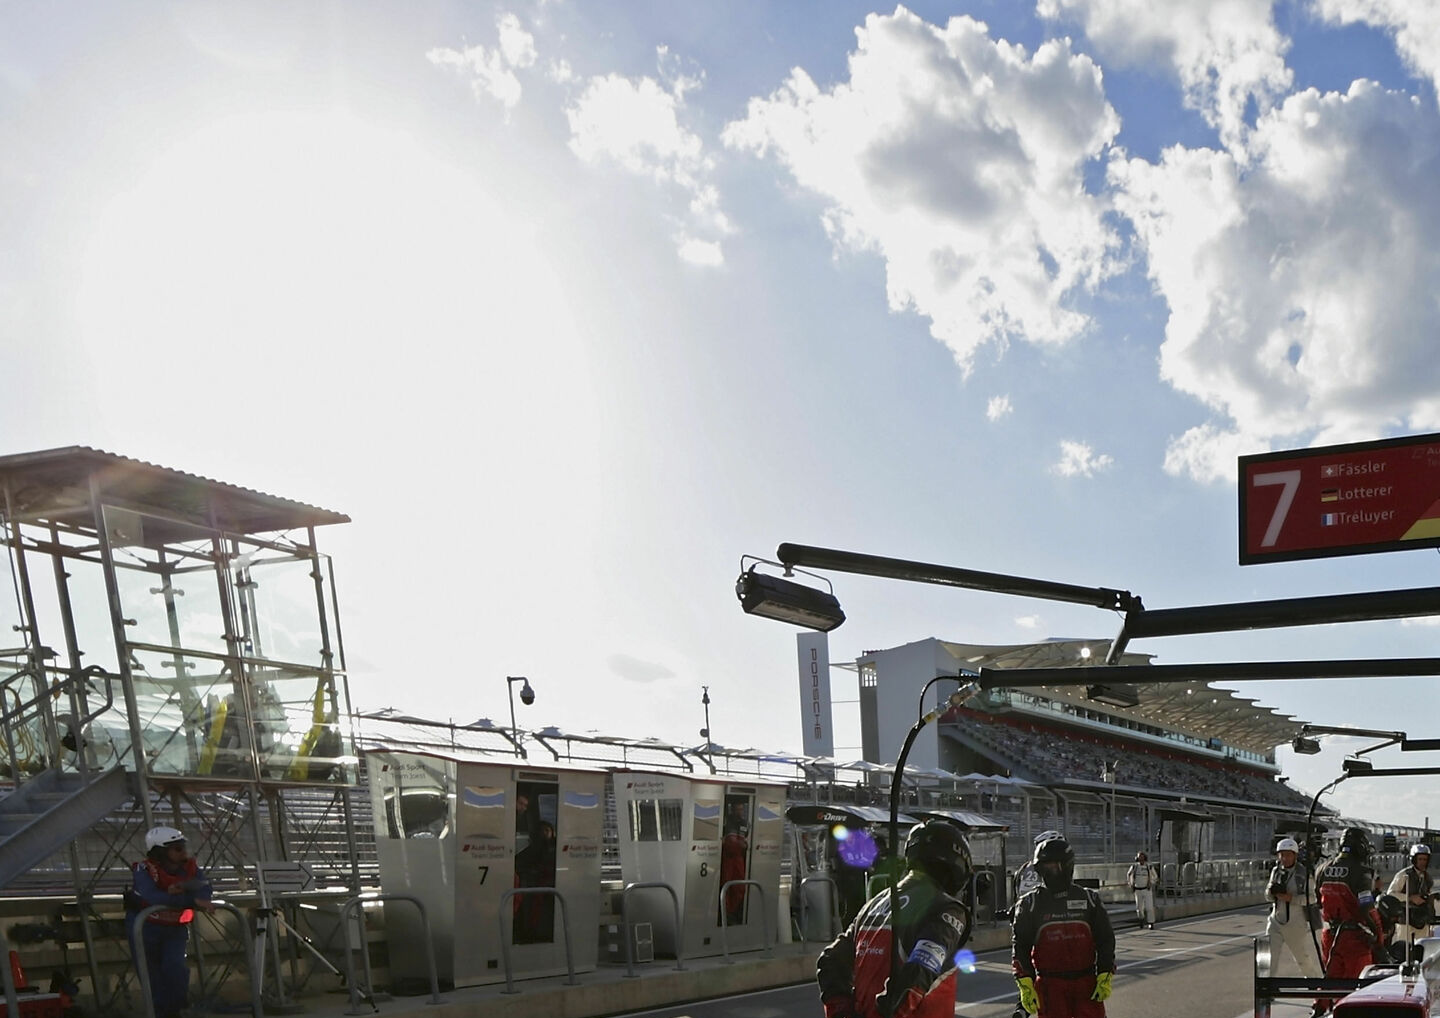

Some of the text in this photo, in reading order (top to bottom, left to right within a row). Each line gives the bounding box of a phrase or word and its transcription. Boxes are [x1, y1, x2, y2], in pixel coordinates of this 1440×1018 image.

[1338, 461, 1386, 475] Fässler
[1338, 486, 1393, 500] Lotterer
[1253, 470, 1301, 547] 7
[1338, 510, 1395, 524] Tréluyer
[810, 648, 822, 740] PORSCHE
[487, 844, 505, 852] Sport
[478, 866, 489, 886] 7
[700, 862, 708, 878] 8
[1026, 871, 1039, 881] 23
